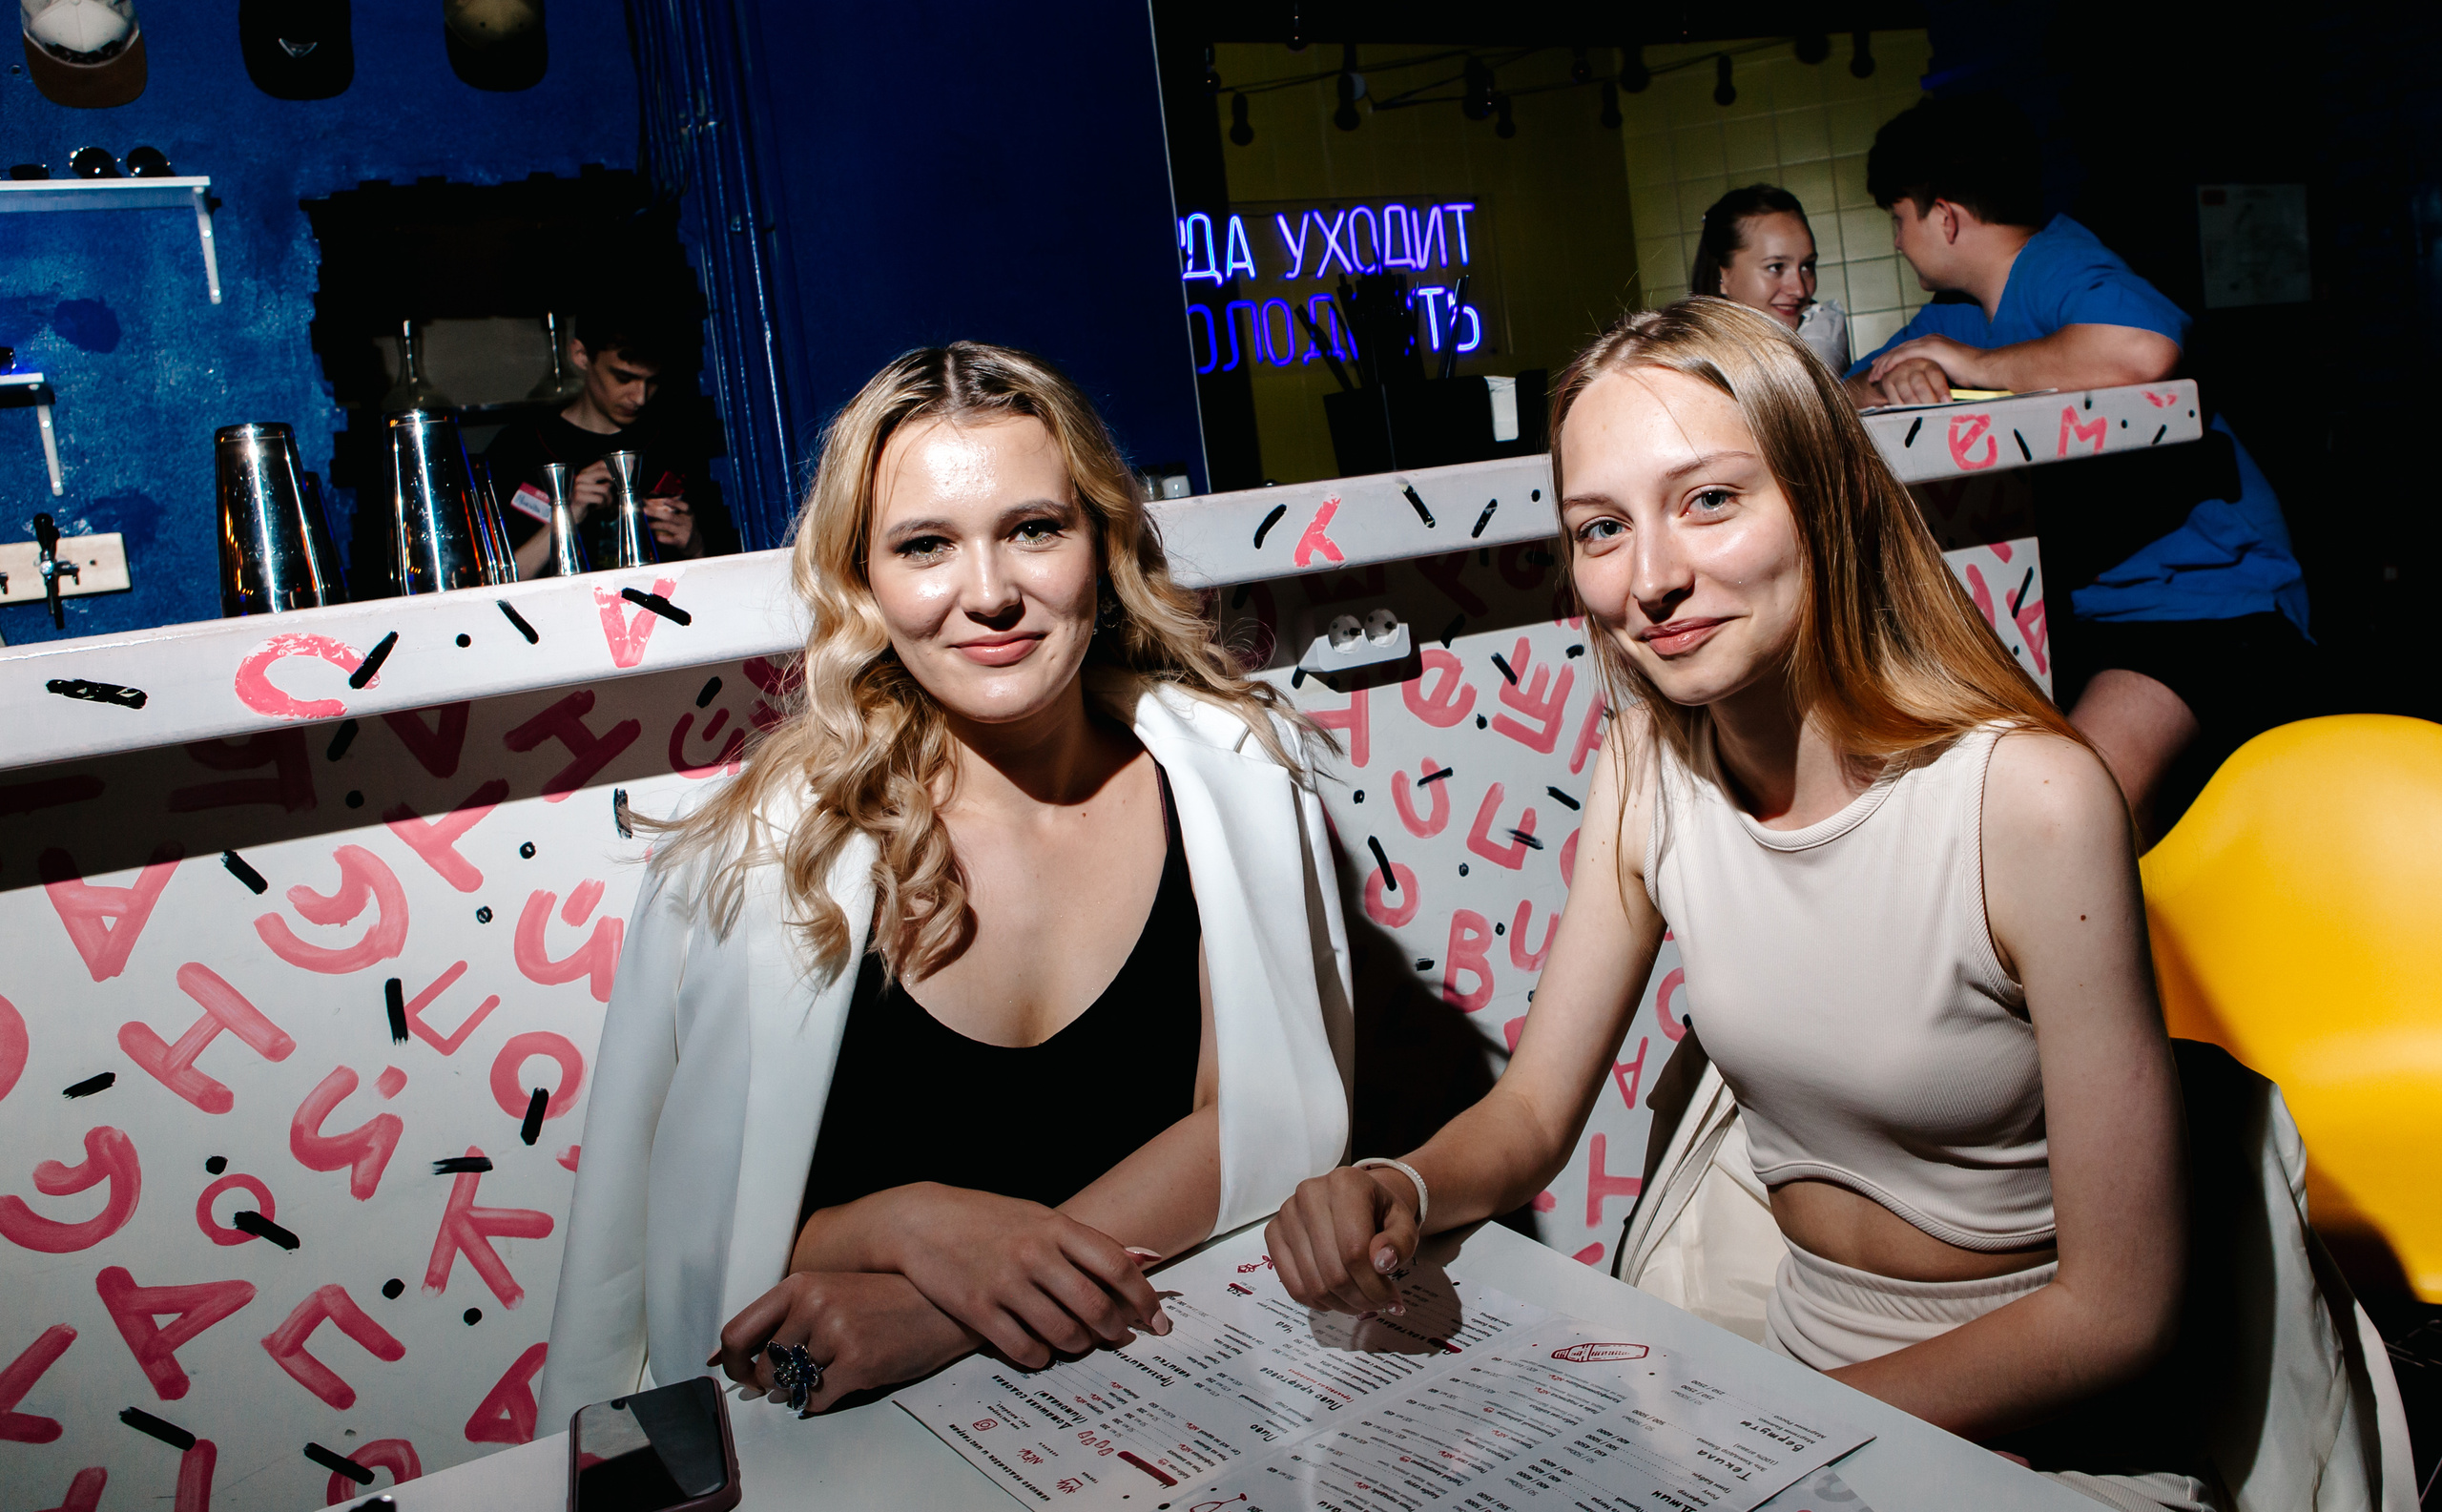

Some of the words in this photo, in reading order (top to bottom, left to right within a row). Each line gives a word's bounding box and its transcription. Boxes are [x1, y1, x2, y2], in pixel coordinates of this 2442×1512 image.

[1179, 213, 1256, 286] ДА
[1275, 202, 1476, 280] УХОДИТ
[1275, 1321, 1293, 1333] Чай
[1153, 1356, 1190, 1377] напитки
[992, 1375, 1027, 1398] содовая
[1260, 1368, 1314, 1394] крафтовое
[1315, 1395, 1343, 1411] Пиво
[1251, 1424, 1277, 1441] Пиво
[1784, 1429, 1815, 1444] Мартини
[1794, 1424, 1826, 1439] Мартини
[1017, 1449, 1043, 1464] NEW
[1541, 1459, 1557, 1467] 4000
[1528, 1465, 1544, 1474] 4000
[1697, 1450, 1751, 1481] Текила
[1517, 1471, 1533, 1480] 4000
[1692, 1473, 1713, 1484] Бабун
[1702, 1490, 1720, 1500] Року
[1714, 1483, 1731, 1493] Грин
[1678, 1490, 1708, 1507] Бифитер
